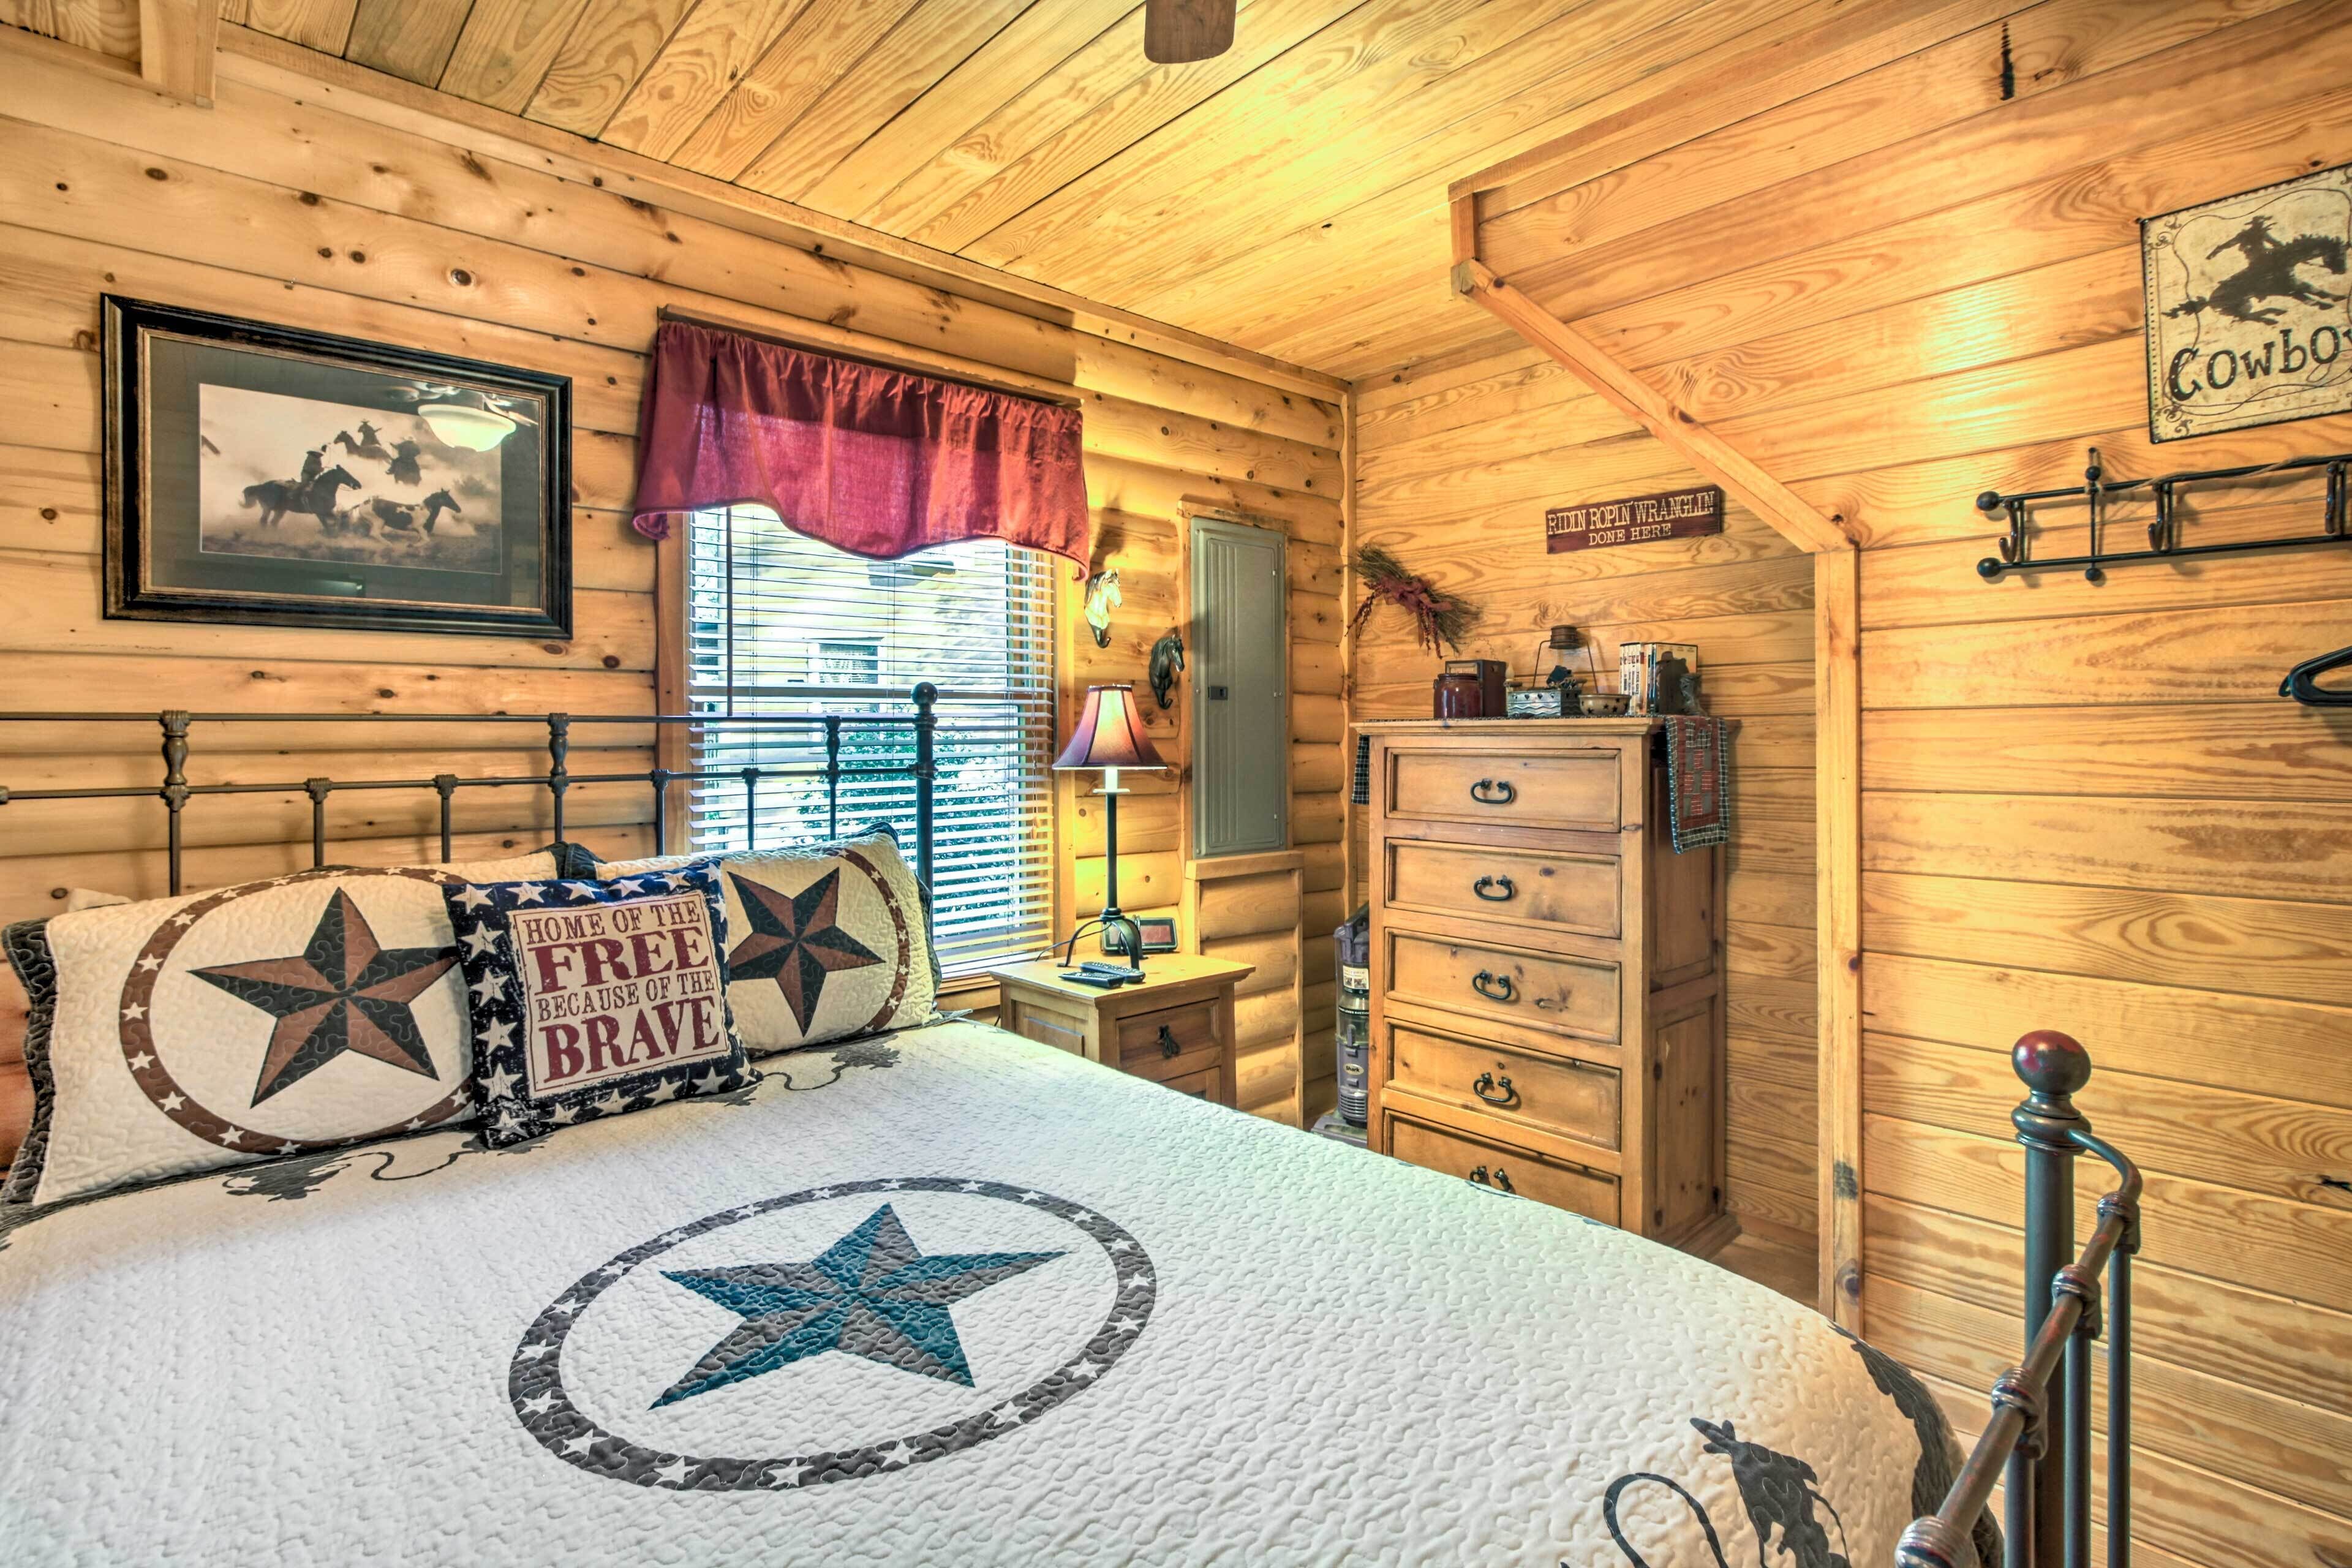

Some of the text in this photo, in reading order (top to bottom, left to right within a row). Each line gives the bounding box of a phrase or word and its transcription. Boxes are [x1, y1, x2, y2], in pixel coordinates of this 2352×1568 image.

[2168, 326, 2352, 401] Cowbo
[1548, 510, 1586, 534] RIDIN
[1634, 491, 1715, 524] WRANGLIN
[1589, 523, 1671, 545] DONE HERE
[522, 900, 701, 945] HOME OF THE
[527, 926, 711, 996] FREE
[535, 970, 716, 1022] BECAUSE OF THE
[539, 995, 720, 1084] BRAVE
